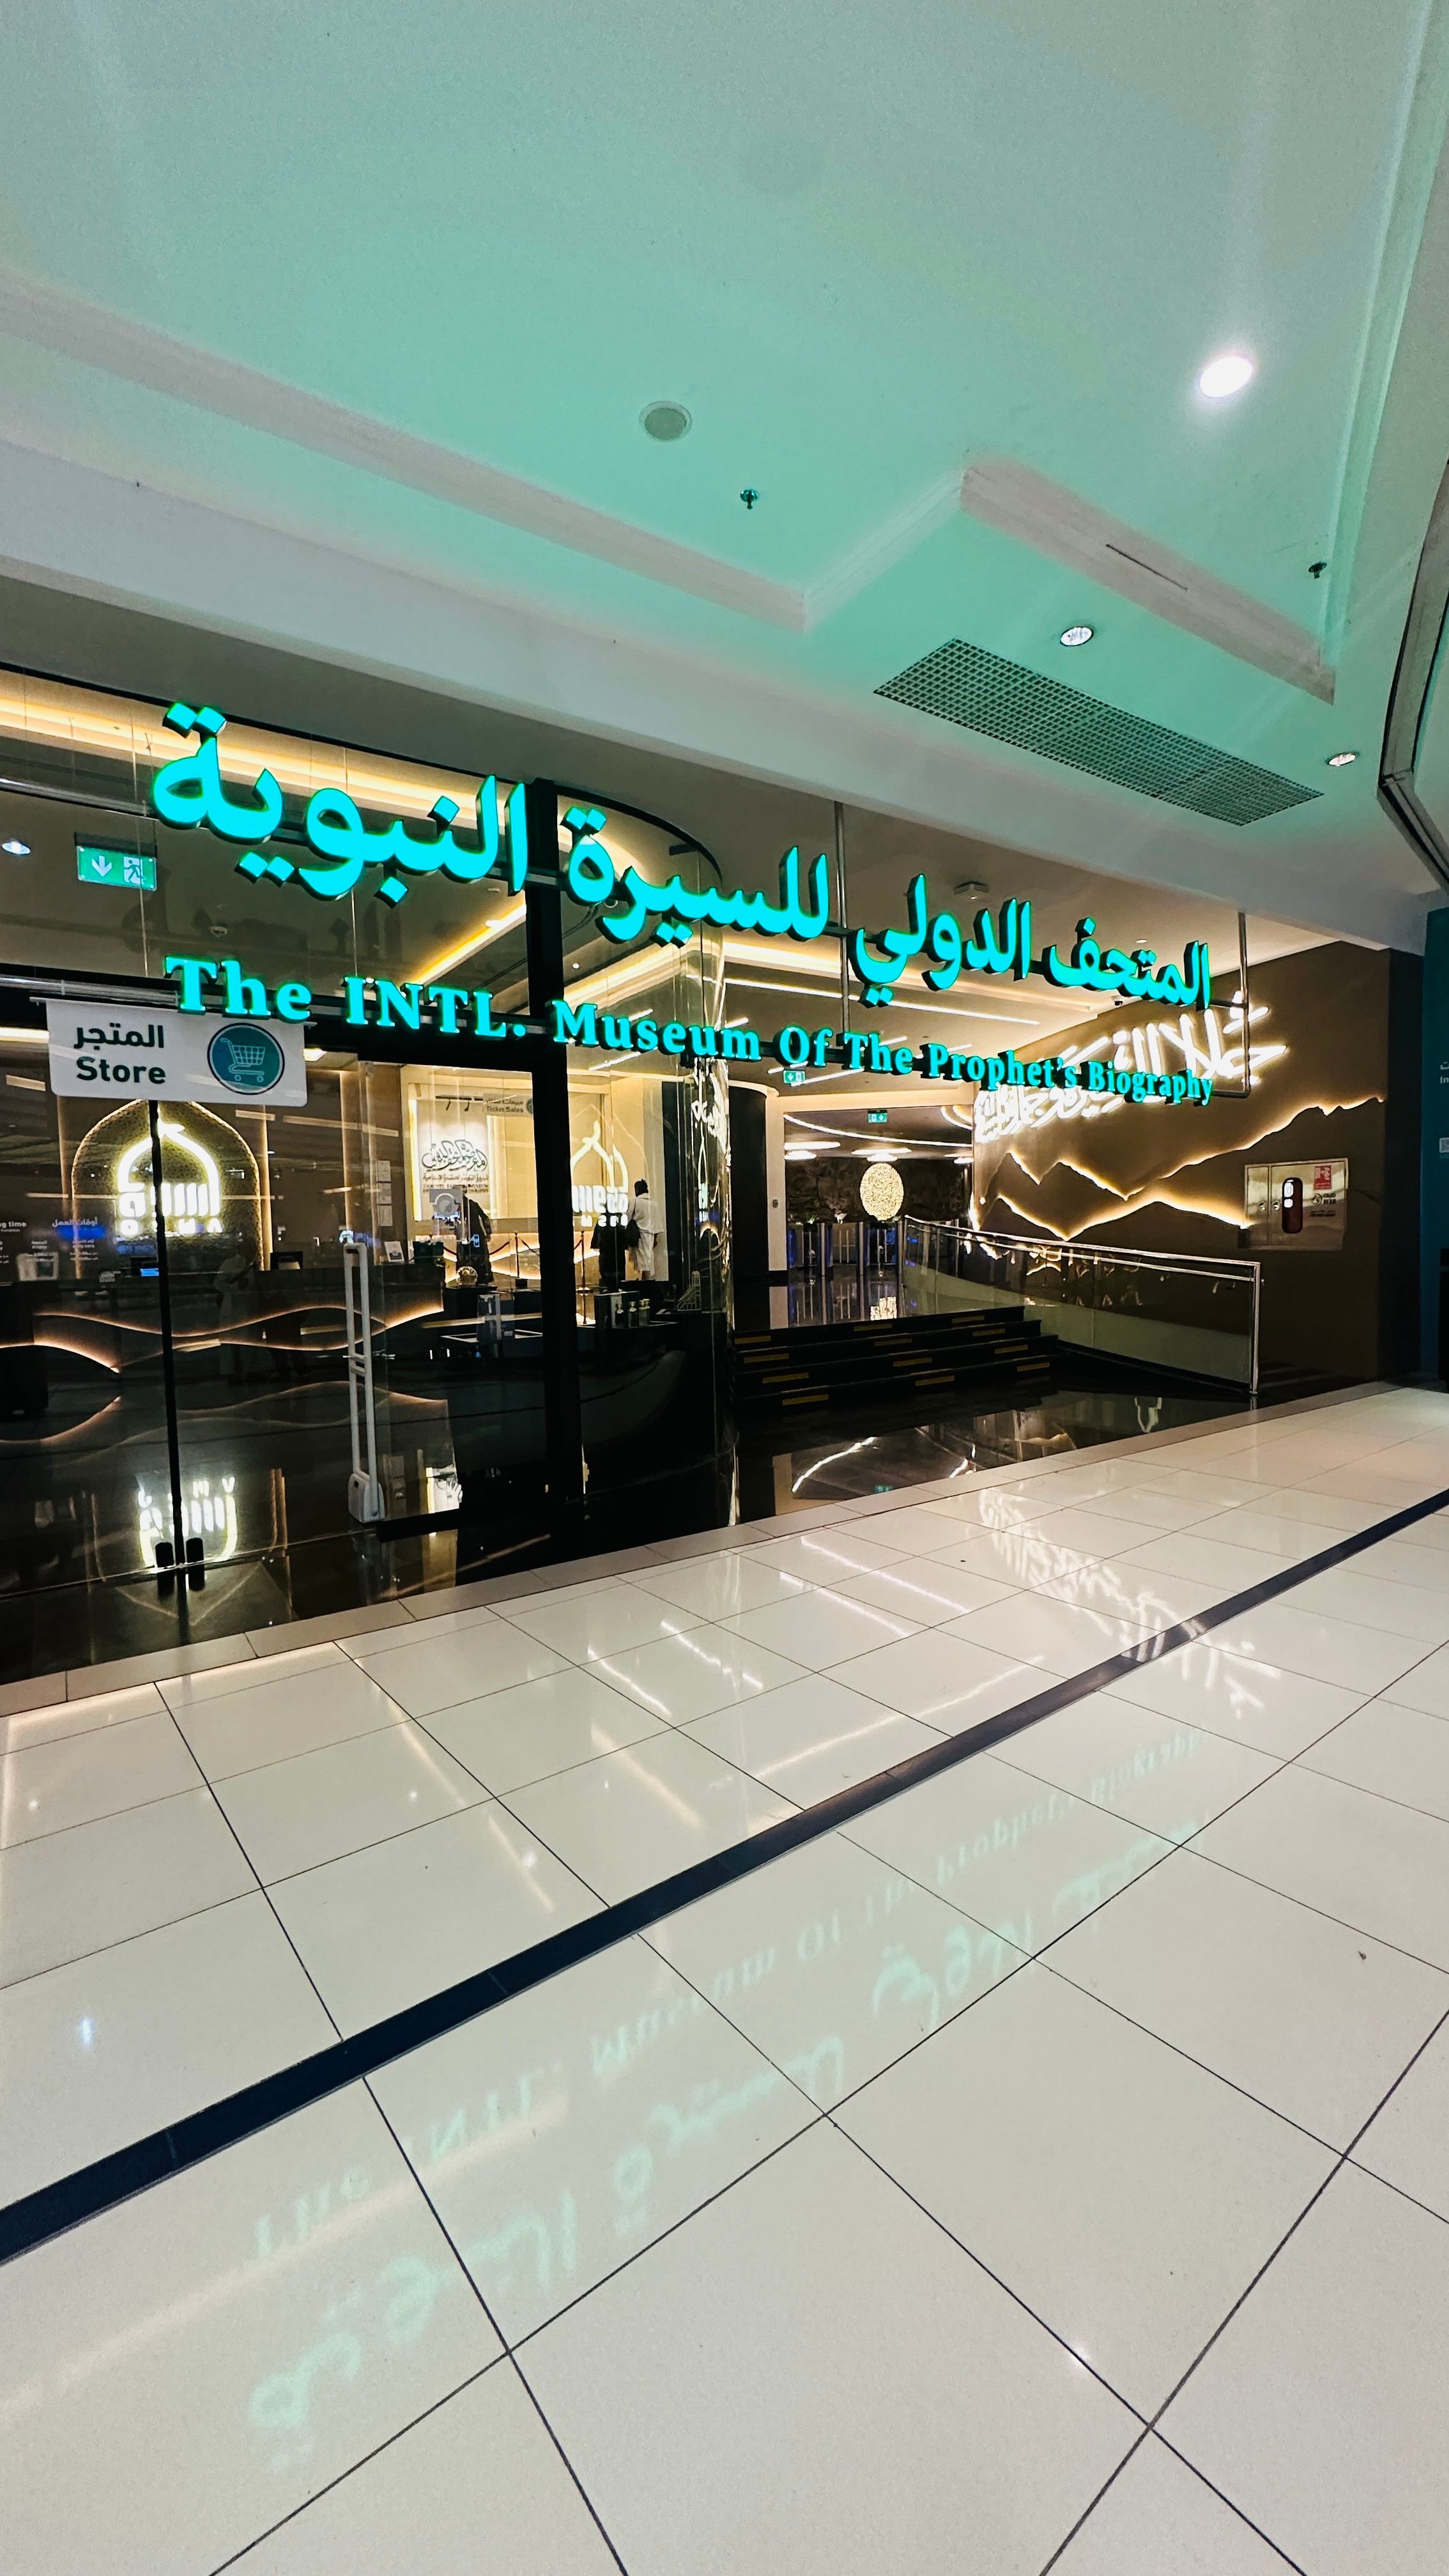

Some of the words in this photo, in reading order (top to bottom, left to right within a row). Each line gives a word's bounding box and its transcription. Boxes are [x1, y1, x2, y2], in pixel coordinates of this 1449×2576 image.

[152, 702, 529, 905] النبوية
[561, 806, 830, 944] للسيرة
[852, 873, 1031, 1006] الدولي
[1045, 917, 1212, 1008] المتحف
[73, 1023, 165, 1051] المتجر
[75, 1056, 167, 1085] Store
[164, 955, 312, 1021] The
[345, 976, 526, 1039] INTL.
[551, 1000, 762, 1061] Museum
[779, 1026, 833, 1068] Of
[842, 1032, 914, 1075] The
[928, 1043, 1078, 1092] Prophet's
[1087, 1061, 1213, 1105] Biography
